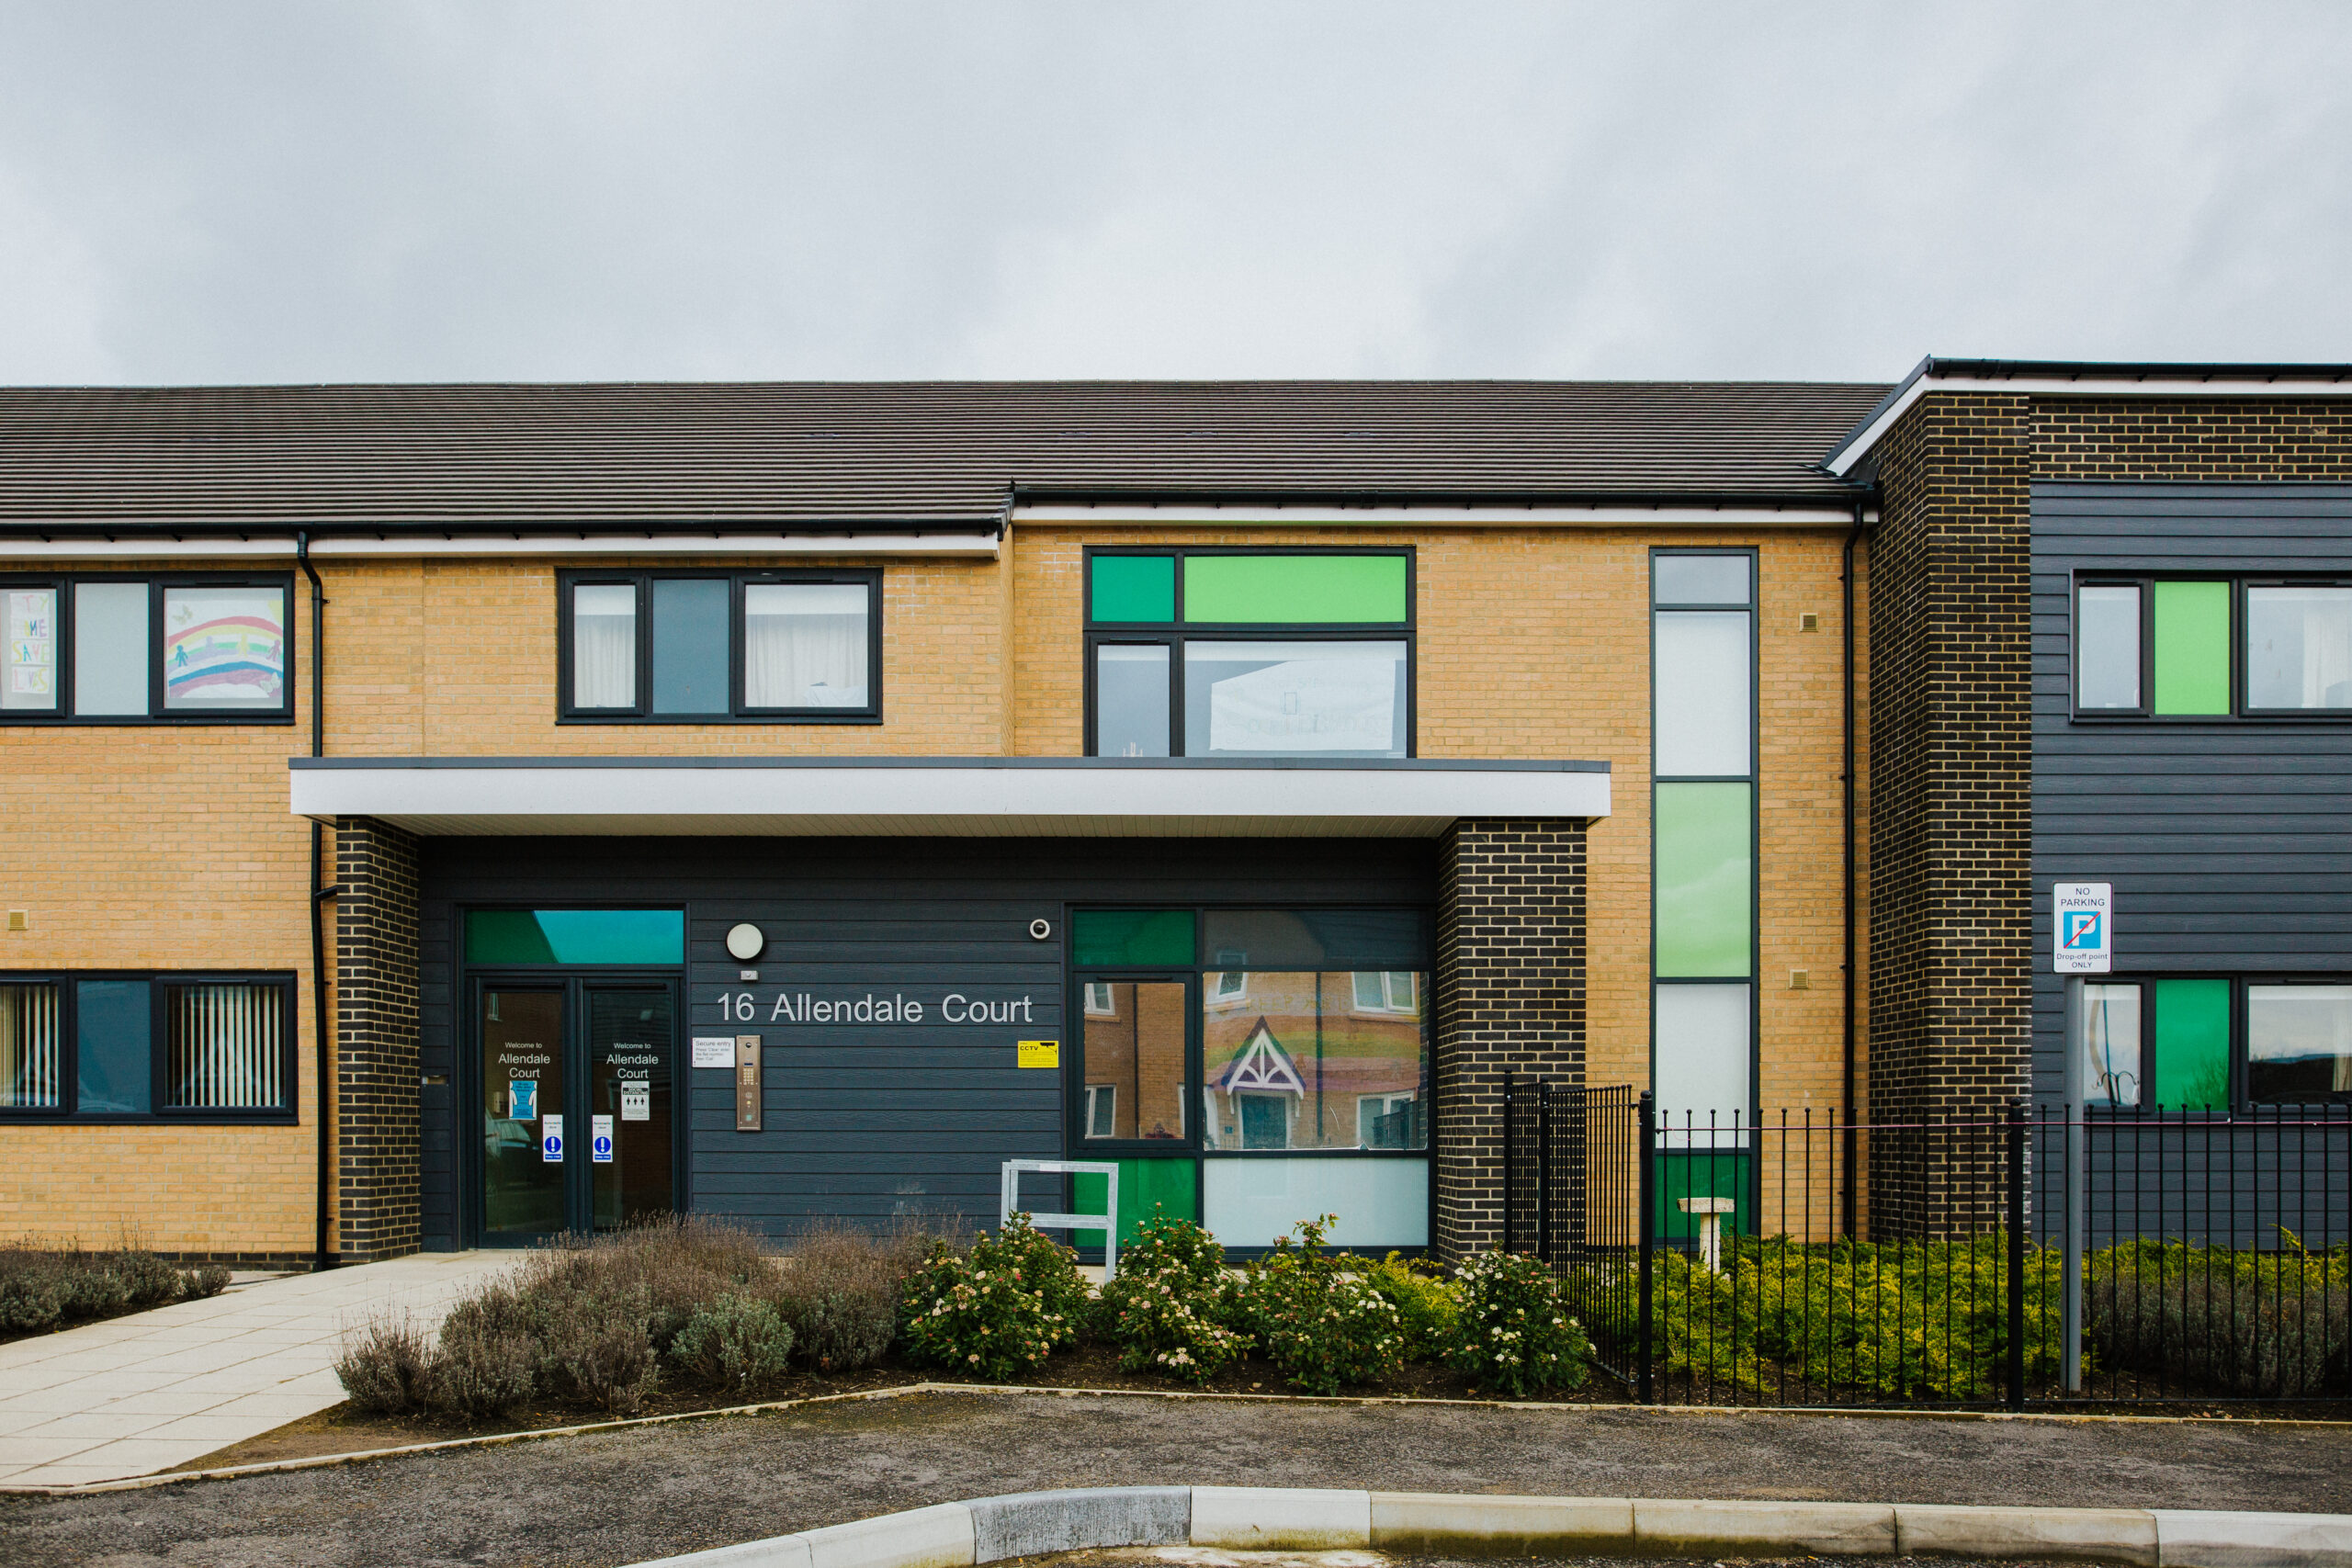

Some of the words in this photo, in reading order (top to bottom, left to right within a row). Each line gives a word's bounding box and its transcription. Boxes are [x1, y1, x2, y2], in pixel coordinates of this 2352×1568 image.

[12, 640, 50, 663] SAVE
[2075, 887, 2090, 896] NO
[2061, 898, 2106, 907] PARKING
[2056, 953, 2087, 961] Drop-off
[2088, 953, 2109, 961] point
[717, 993, 755, 1021] 16
[770, 993, 923, 1022] Allendale
[941, 994, 1033, 1022] Court
[498, 1053, 550, 1064] Allendale
[606, 1054, 659, 1065] Allendale
[509, 1067, 540, 1078] Court
[617, 1068, 649, 1079] Court
